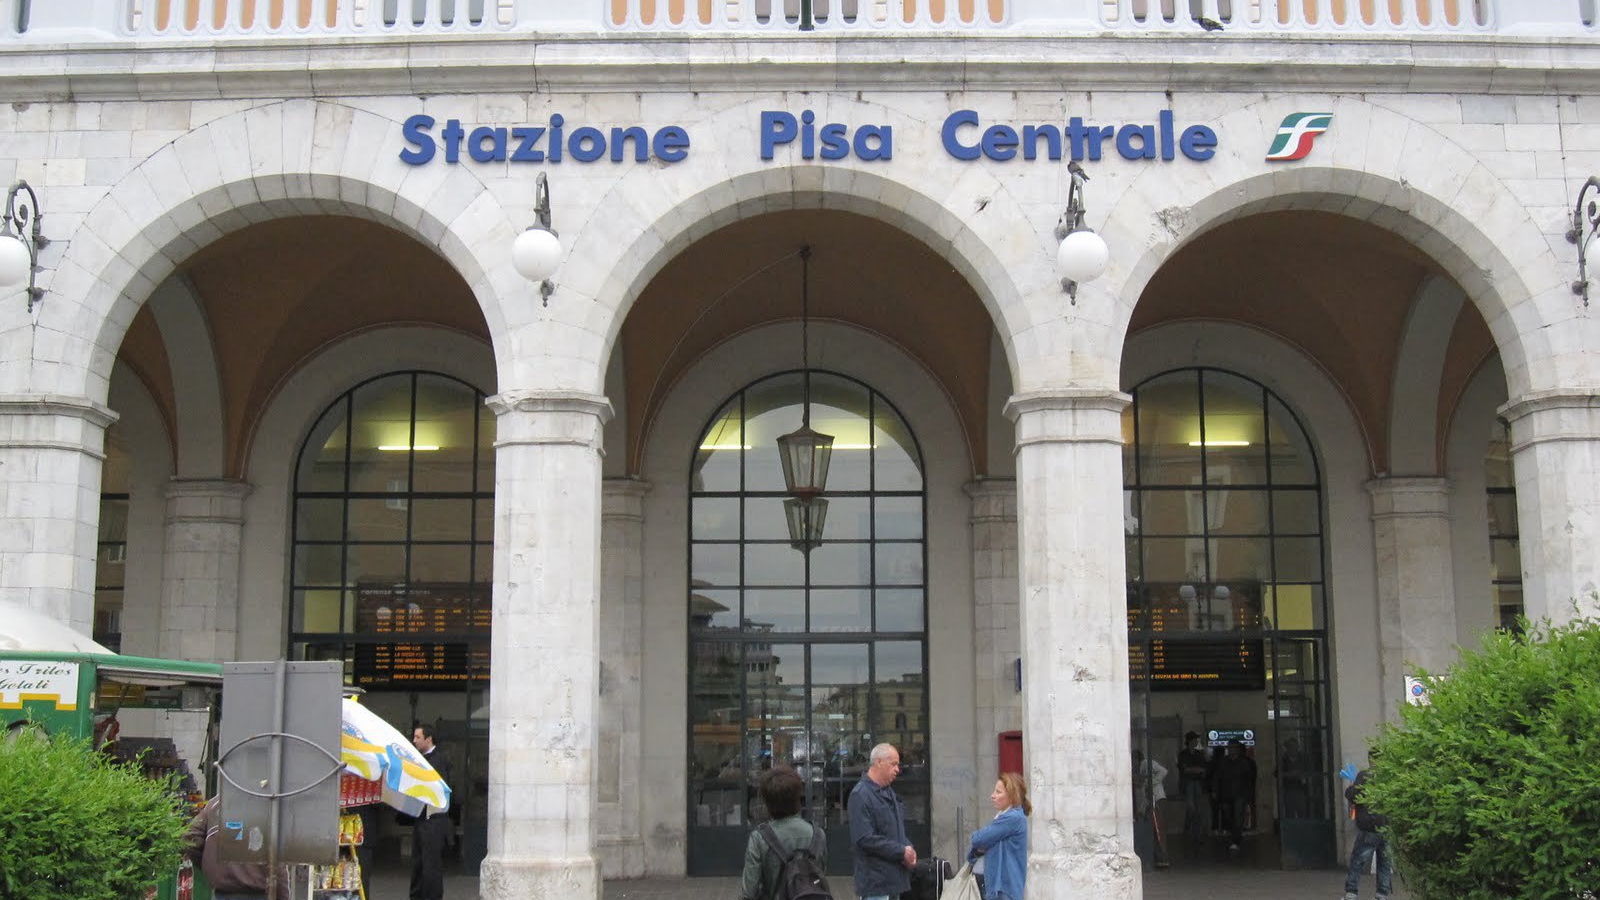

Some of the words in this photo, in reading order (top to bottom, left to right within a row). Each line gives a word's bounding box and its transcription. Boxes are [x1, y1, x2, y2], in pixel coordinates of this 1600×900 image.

[400, 114, 690, 165] Stazione
[761, 110, 892, 160] Pisa
[942, 110, 1218, 160] Centrale
